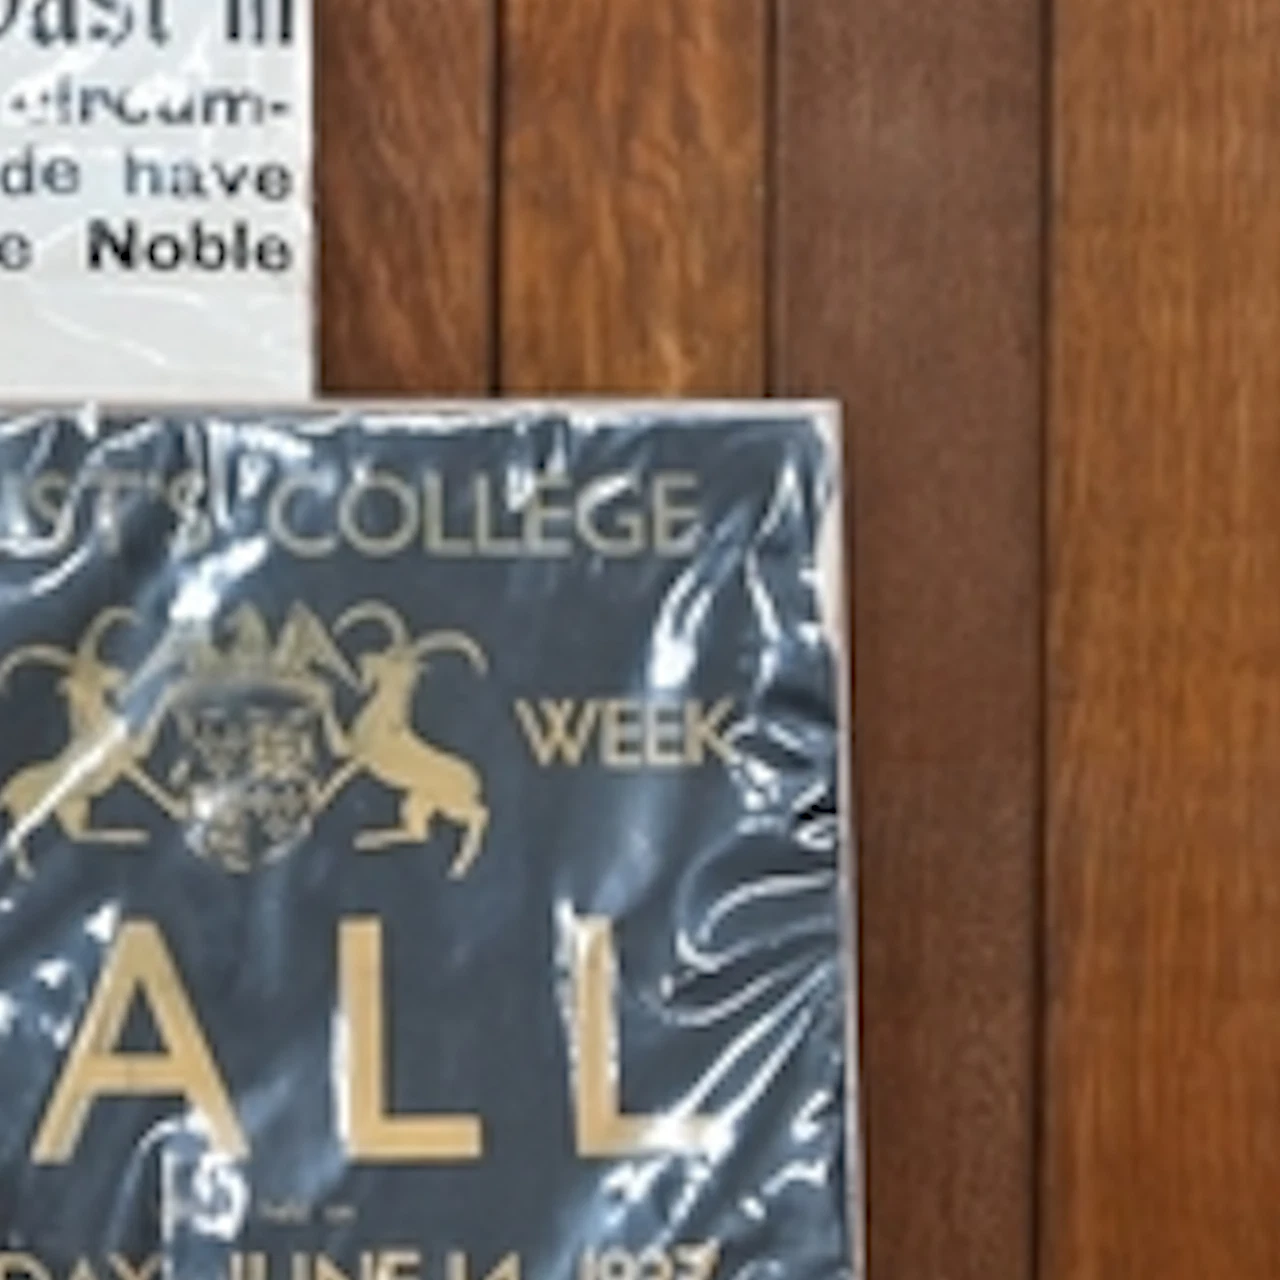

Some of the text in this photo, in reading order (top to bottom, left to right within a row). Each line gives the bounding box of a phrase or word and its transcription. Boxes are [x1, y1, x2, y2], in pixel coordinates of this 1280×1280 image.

[124, 147, 294, 202] have
[87, 217, 293, 272] Noble
[269, 468, 700, 558] COLLEGE
[513, 697, 735, 771] WEEK
